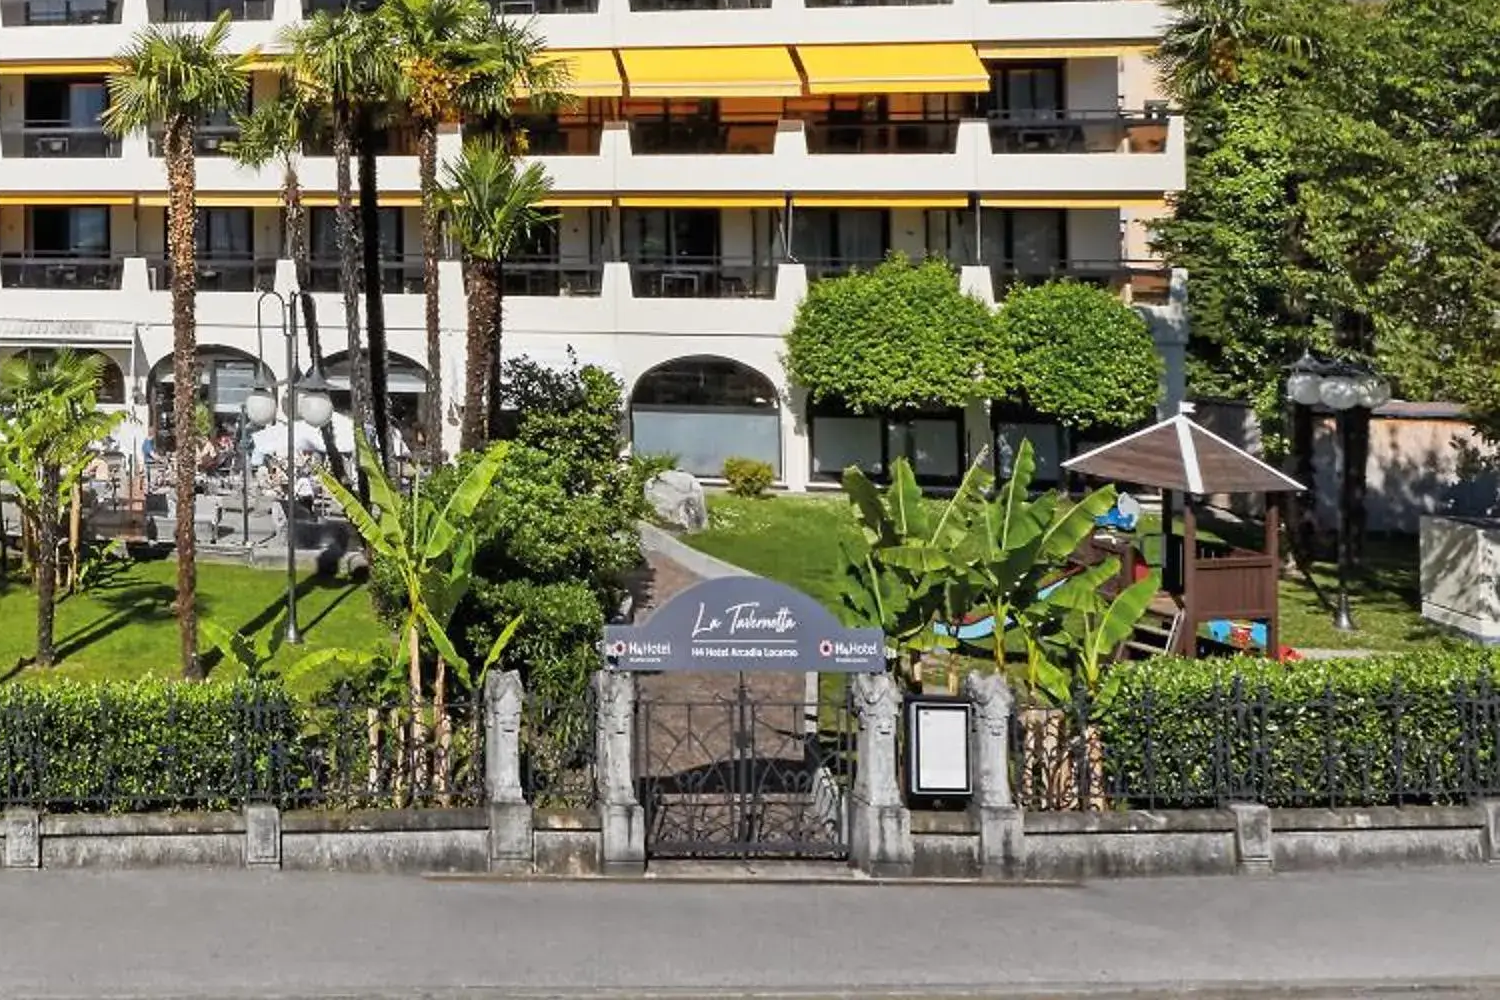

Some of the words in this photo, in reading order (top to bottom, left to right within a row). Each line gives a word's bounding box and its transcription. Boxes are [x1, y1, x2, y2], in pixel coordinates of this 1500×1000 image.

[691, 601, 722, 638] La
[724, 601, 797, 635] Tavernetta
[705, 647, 729, 657] Hotel
[731, 647, 763, 657] Arcadia
